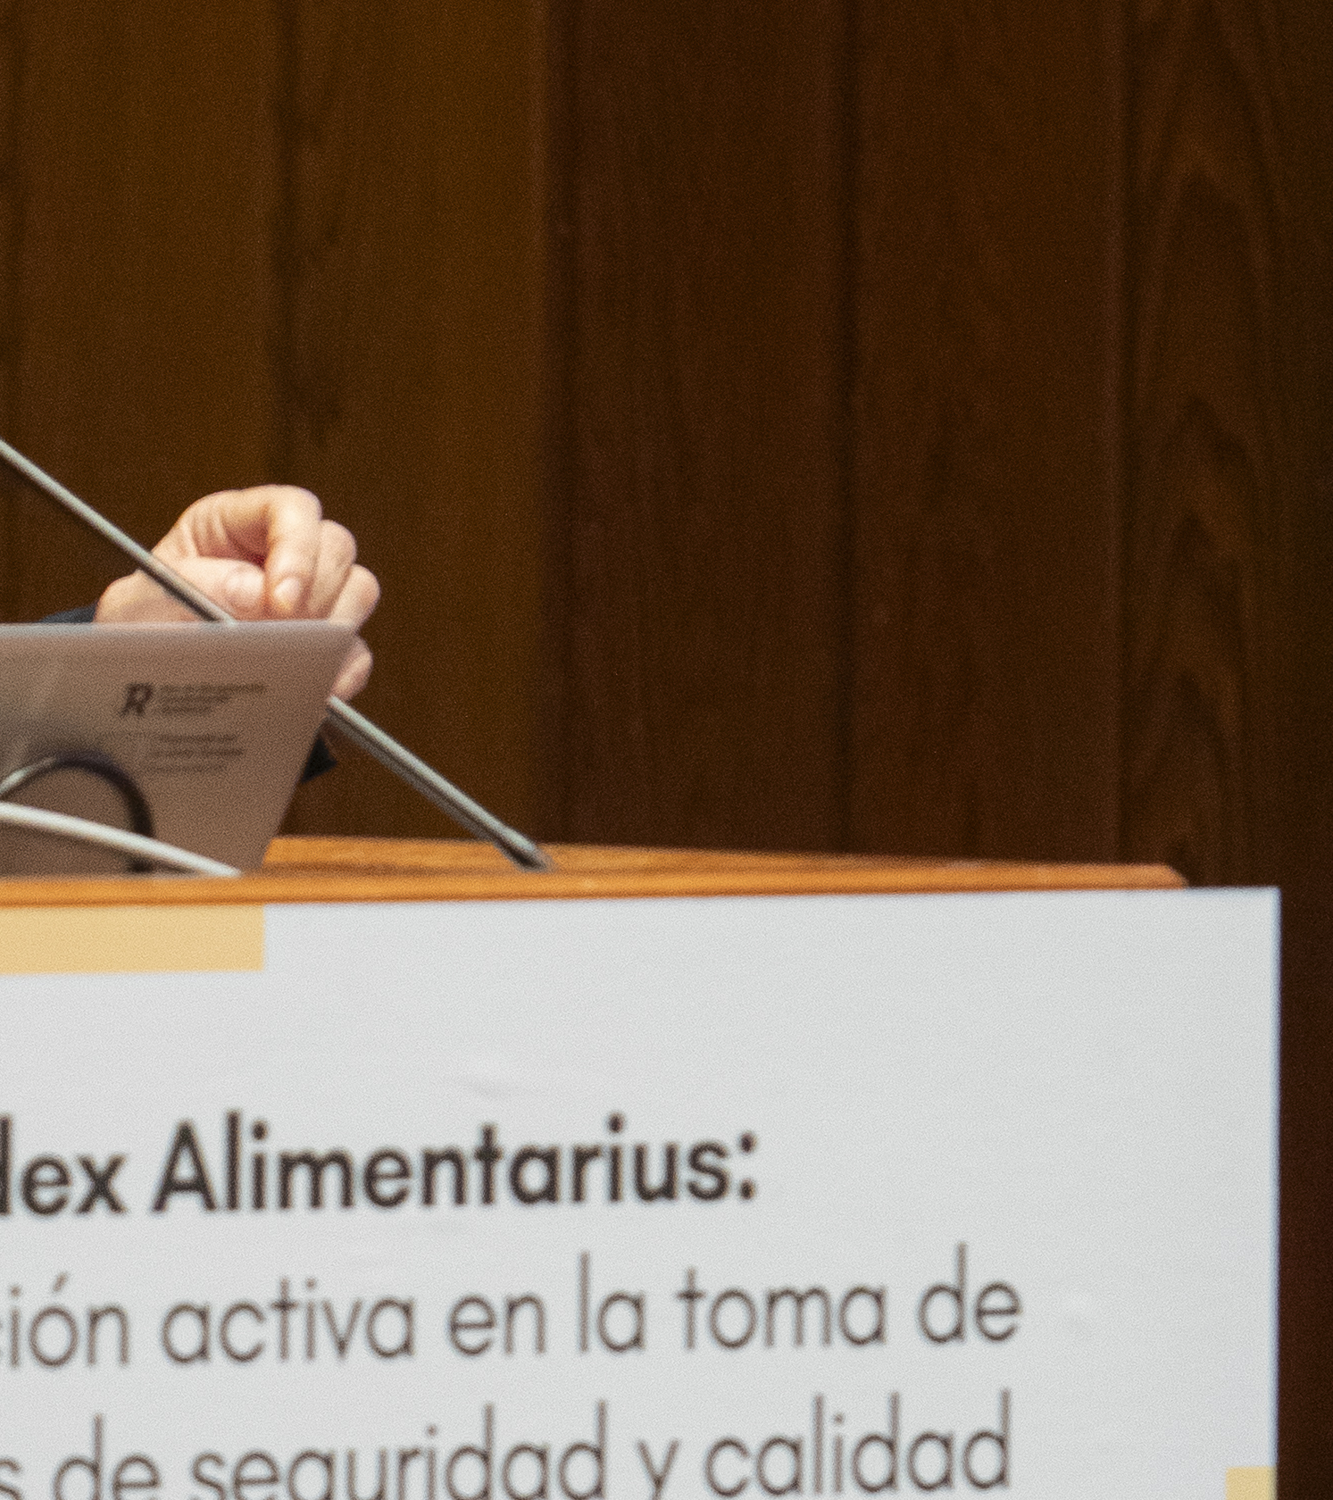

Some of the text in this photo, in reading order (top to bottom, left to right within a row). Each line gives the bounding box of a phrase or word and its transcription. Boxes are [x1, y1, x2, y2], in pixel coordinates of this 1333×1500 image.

[148, 1106, 760, 1215] Alimentarius:
[158, 1278, 418, 1369] activa
[444, 1291, 549, 1361] en
[576, 1251, 648, 1357] la
[673, 1267, 889, 1354] toma
[915, 1241, 1025, 1349] de
[701, 1388, 1013, 1500] calidad
